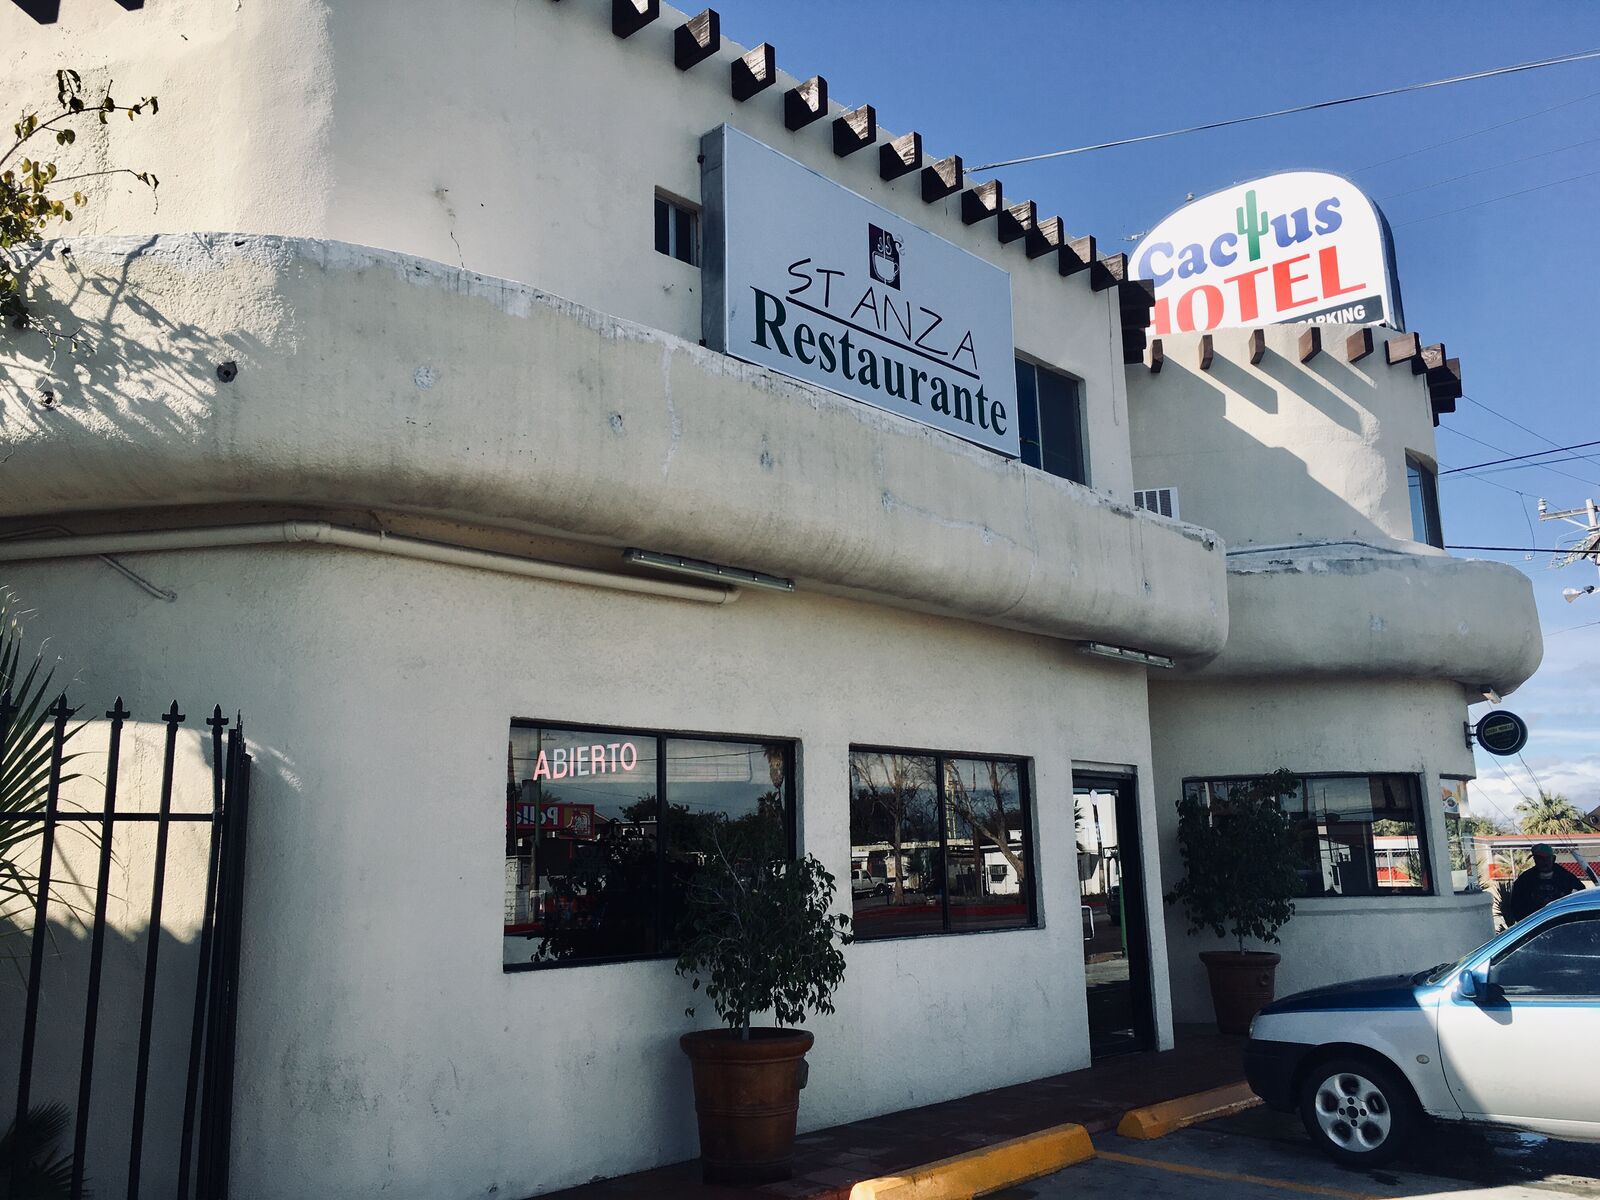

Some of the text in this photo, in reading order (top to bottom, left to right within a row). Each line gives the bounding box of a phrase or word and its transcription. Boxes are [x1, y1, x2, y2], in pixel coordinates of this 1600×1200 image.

[1138, 190, 1343, 288] Cactus
[1296, 304, 1366, 325] RKING
[749, 285, 1008, 436] Restaurante
[533, 743, 637, 780] ABIERTO
